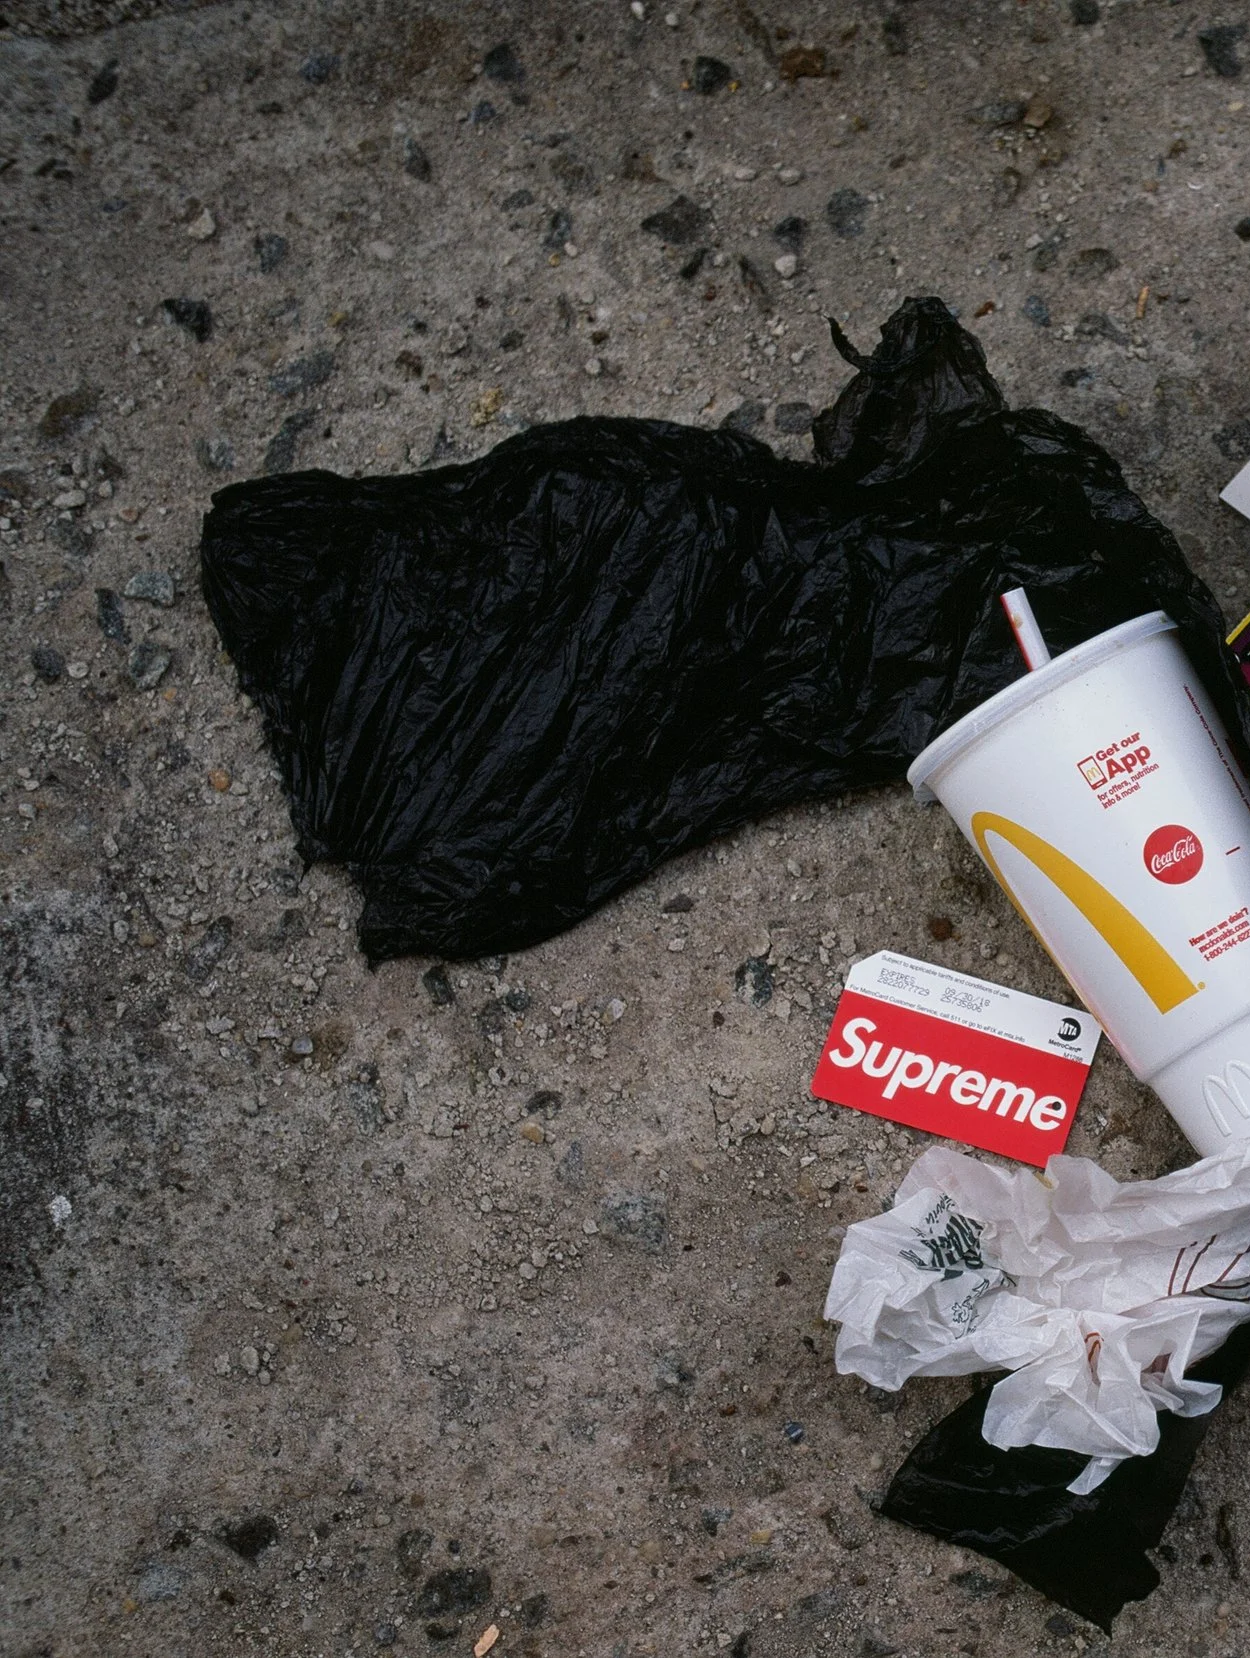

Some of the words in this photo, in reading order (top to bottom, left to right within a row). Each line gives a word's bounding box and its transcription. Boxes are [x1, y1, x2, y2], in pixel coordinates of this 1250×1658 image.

[1095, 743, 1119, 760] Get
[1120, 732, 1139, 747] our
[1106, 746, 1150, 778] App
[1097, 792, 1107, 801] for
[1108, 780, 1131, 795] offers,
[1130, 763, 1159, 781] nutrition
[1101, 798, 1115, 808] info
[1114, 793, 1121, 801] &
[1120, 781, 1140, 797] more!
[1150, 834, 1196, 875] Coca-Cola
[1188, 933, 1205, 946] How
[1205, 927, 1217, 937] are
[1217, 920, 1228, 929] we
[1198, 920, 1249, 952] mcdonalds.com
[880, 967, 914, 984] EXPIRES
[944, 987, 990, 1006] 09/30/18
[881, 954, 902, 964] Subject
[909, 964, 937, 975] applicable
[937, 972, 953, 981] tariffs
[964, 981, 992, 993] conditions
[859, 987, 888, 1000] MetroCard
[889, 996, 915, 1007] Customer
[916, 1004, 937, 1015] Service,
[968, 1021, 975, 1029] go
[877, 975, 929, 996] 2822077729
[940, 994, 982, 1012] 25735806
[1057, 1020, 1076, 1035] MTA
[829, 1017, 1067, 1131] Supreme
